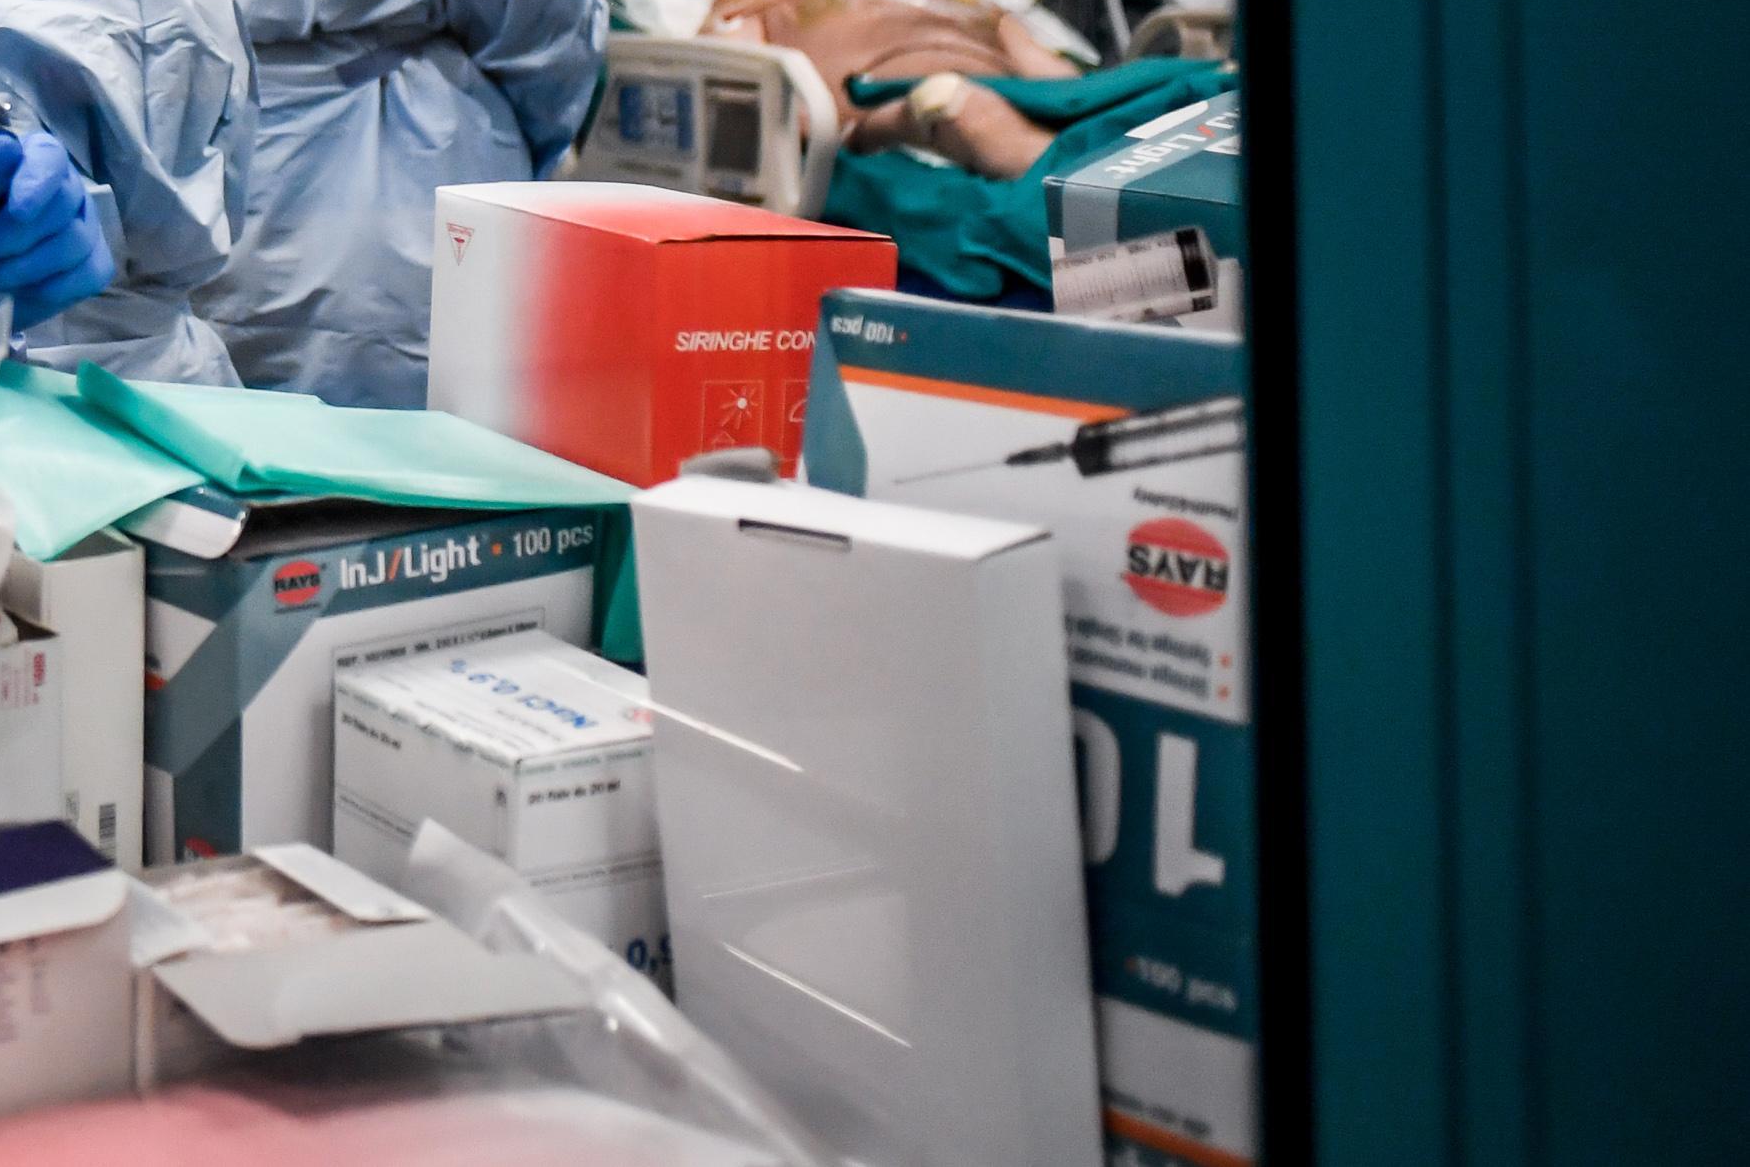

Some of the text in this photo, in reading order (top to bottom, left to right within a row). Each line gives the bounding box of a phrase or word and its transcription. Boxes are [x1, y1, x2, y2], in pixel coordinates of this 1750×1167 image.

[675, 330, 772, 352] SIRINGHE
[831, 316, 895, 345] 100 pcs
[513, 527, 551, 558] 100
[556, 524, 594, 554] pcs
[1128, 543, 1229, 592] RAYS
